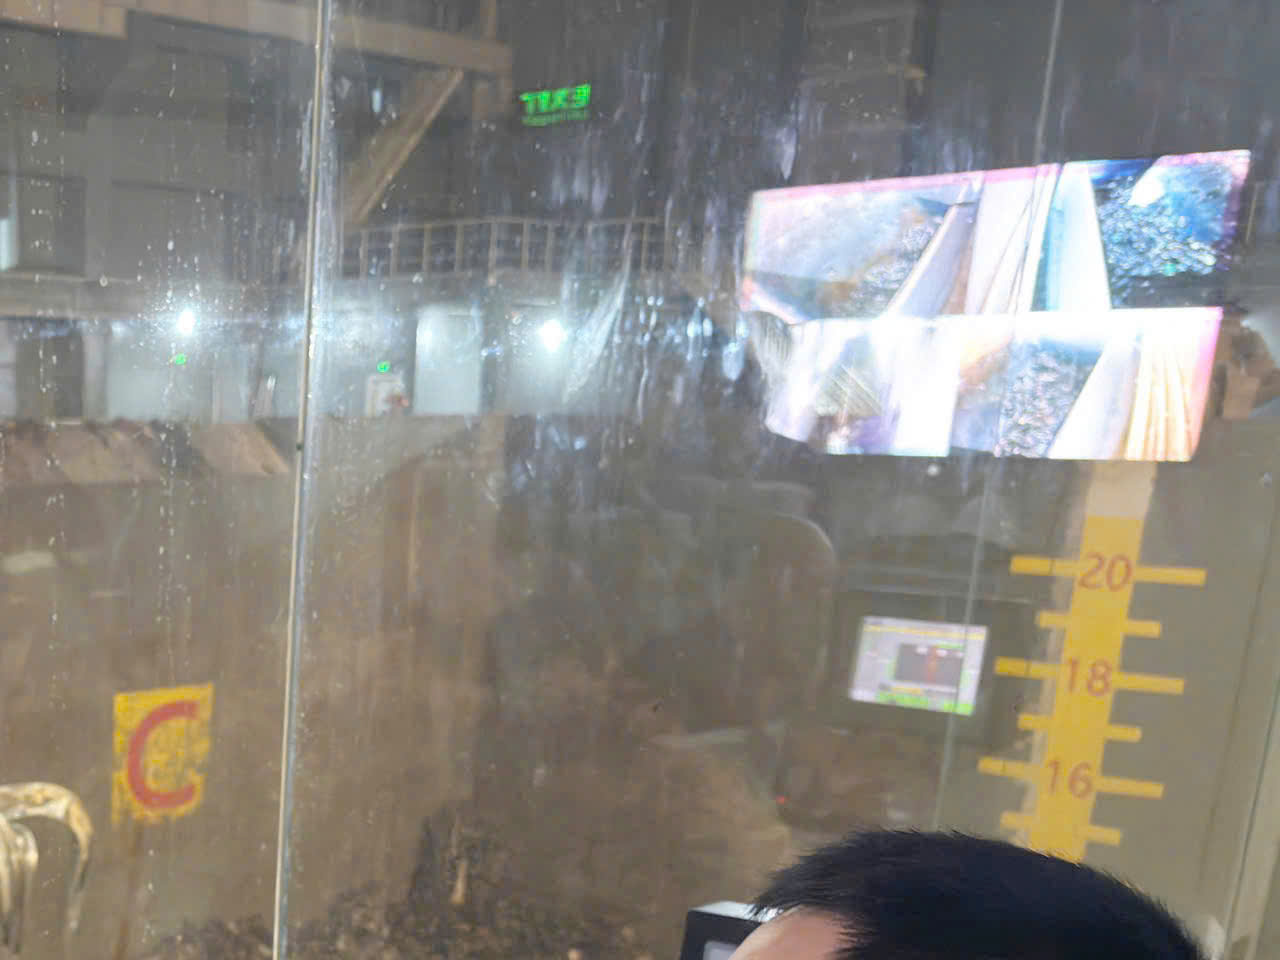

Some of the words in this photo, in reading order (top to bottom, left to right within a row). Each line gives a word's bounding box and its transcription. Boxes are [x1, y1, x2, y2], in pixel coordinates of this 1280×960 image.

[1078, 552, 1132, 592] 20
[1066, 656, 1113, 697] 18
[128, 700, 198, 810] C
[1047, 760, 1094, 799] 16
